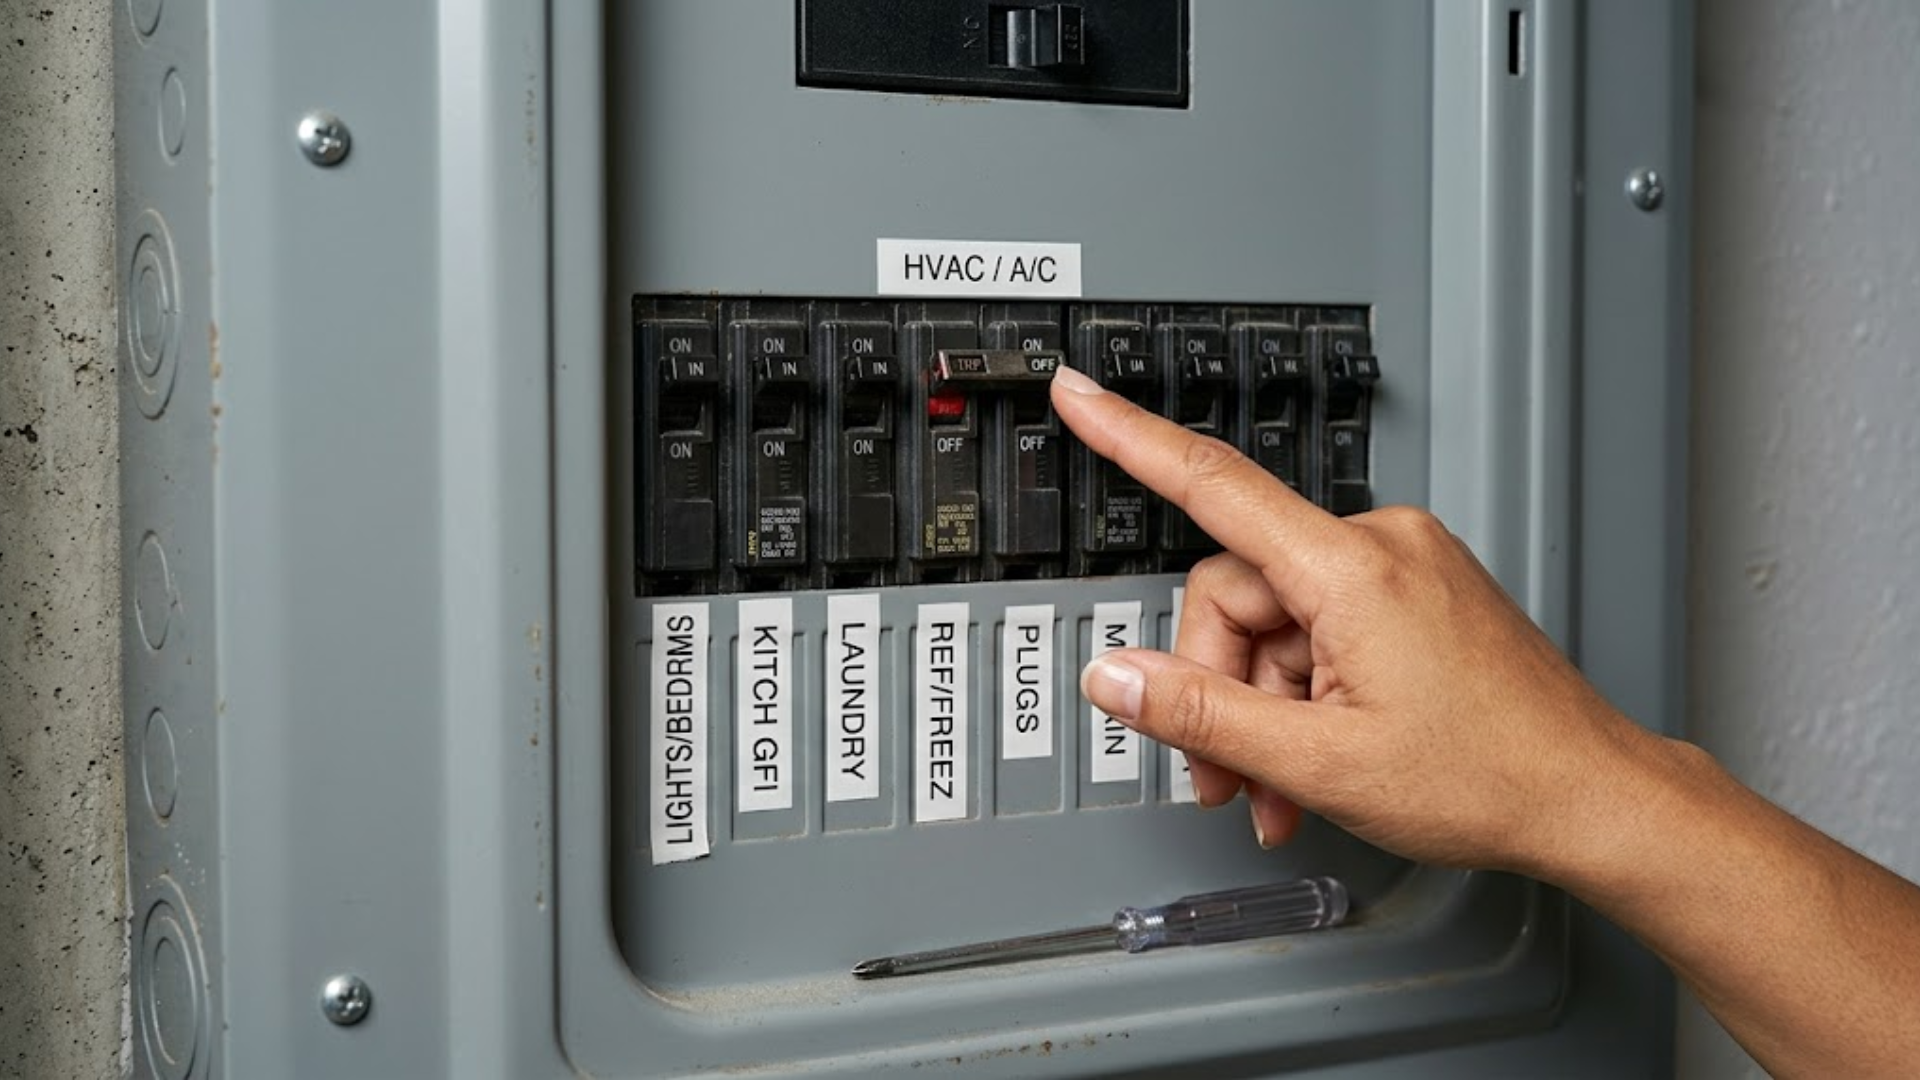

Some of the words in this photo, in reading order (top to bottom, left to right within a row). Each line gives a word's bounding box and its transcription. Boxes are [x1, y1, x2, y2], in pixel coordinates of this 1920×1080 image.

[904, 253, 985, 282] HVAC
[992, 255, 1002, 282] /
[1008, 256, 1057, 283] A/C
[669, 337, 692, 353] ON
[762, 337, 785, 353] ON
[852, 338, 873, 353] ON
[1023, 338, 1042, 351] ON
[1187, 339, 1206, 354] ON
[670, 442, 693, 458] ON
[763, 440, 785, 457] ON
[853, 439, 874, 455] ON
[936, 437, 964, 452] OFF
[1019, 436, 1046, 451] OFF
[752, 625, 779, 725] KITCH
[1015, 625, 1040, 734] PLUGS
[840, 622, 866, 781] LAUNDRY
[929, 621, 955, 801] REF/FREEZ
[665, 614, 695, 845] LIGHTS/BEDRMS
[752, 737, 779, 791] GFI
